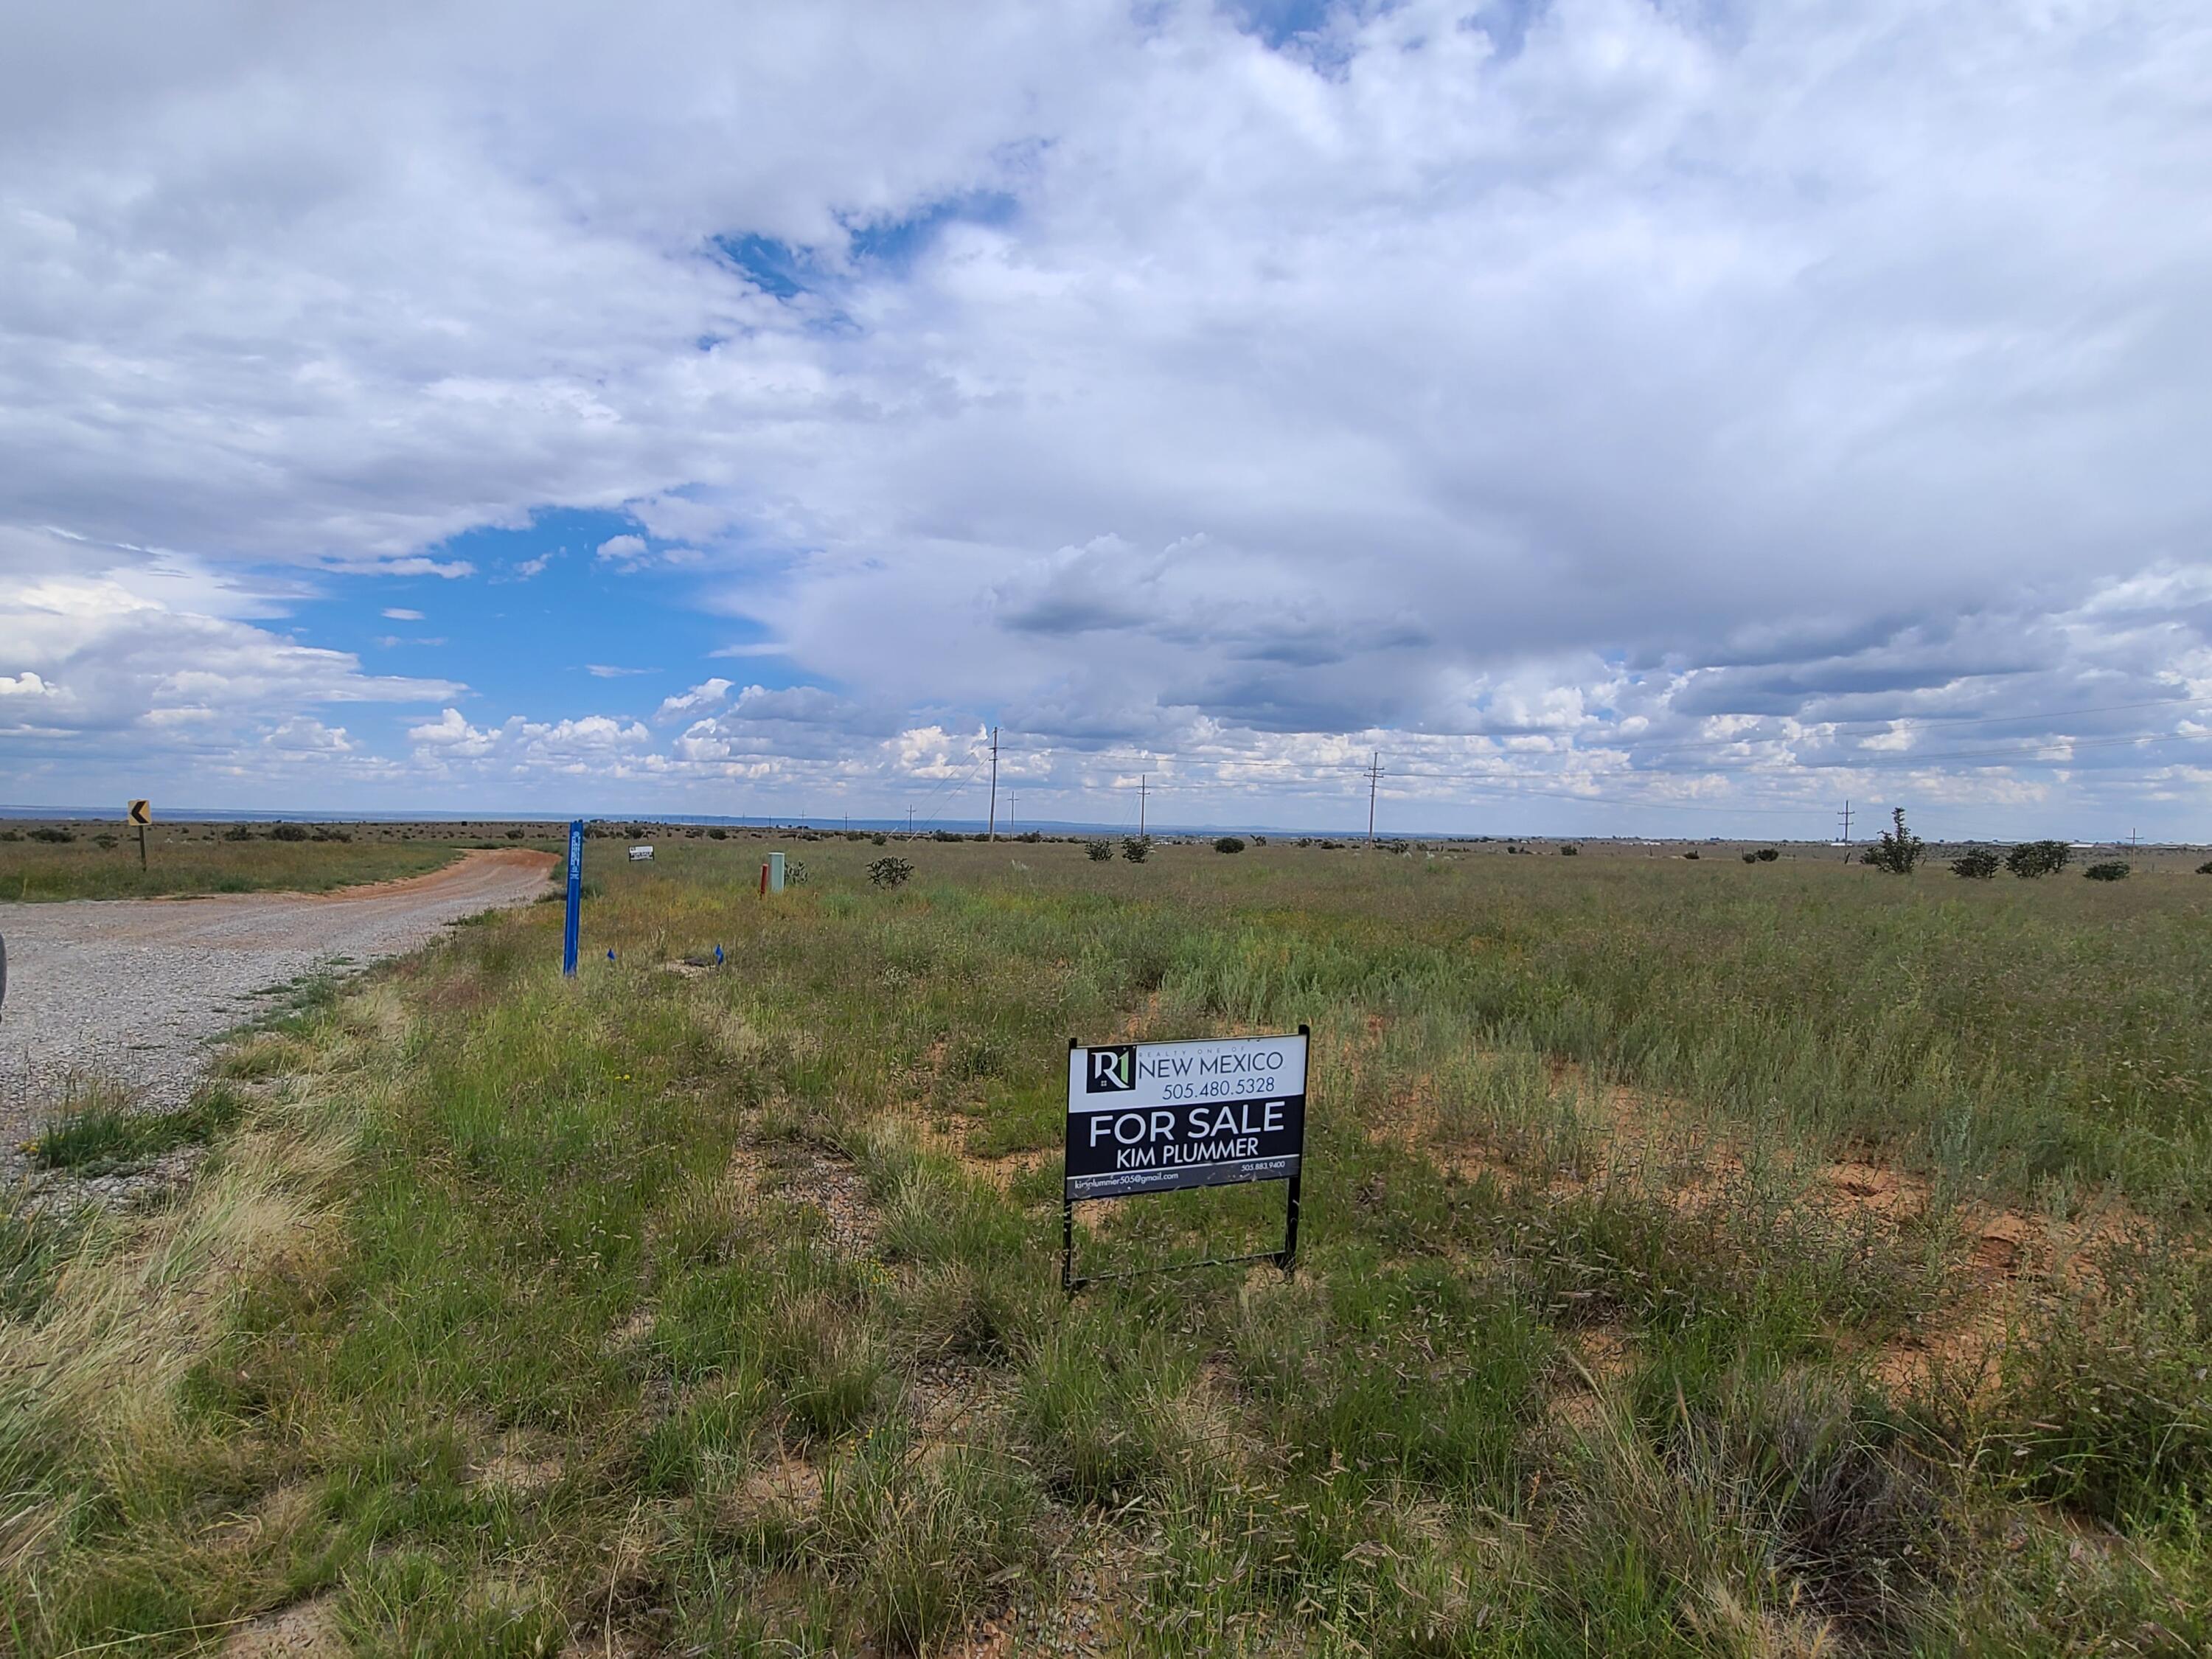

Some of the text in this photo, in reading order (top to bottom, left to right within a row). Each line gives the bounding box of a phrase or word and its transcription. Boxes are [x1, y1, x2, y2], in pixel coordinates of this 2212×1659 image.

[1138, 1051, 1284, 1079] NEW MEXICO
[1162, 1077, 1275, 1100] 505.480.5328
[1090, 1101, 1285, 1147] FOR SALE
[1116, 1138, 1259, 1169] KIM PLUMMER
